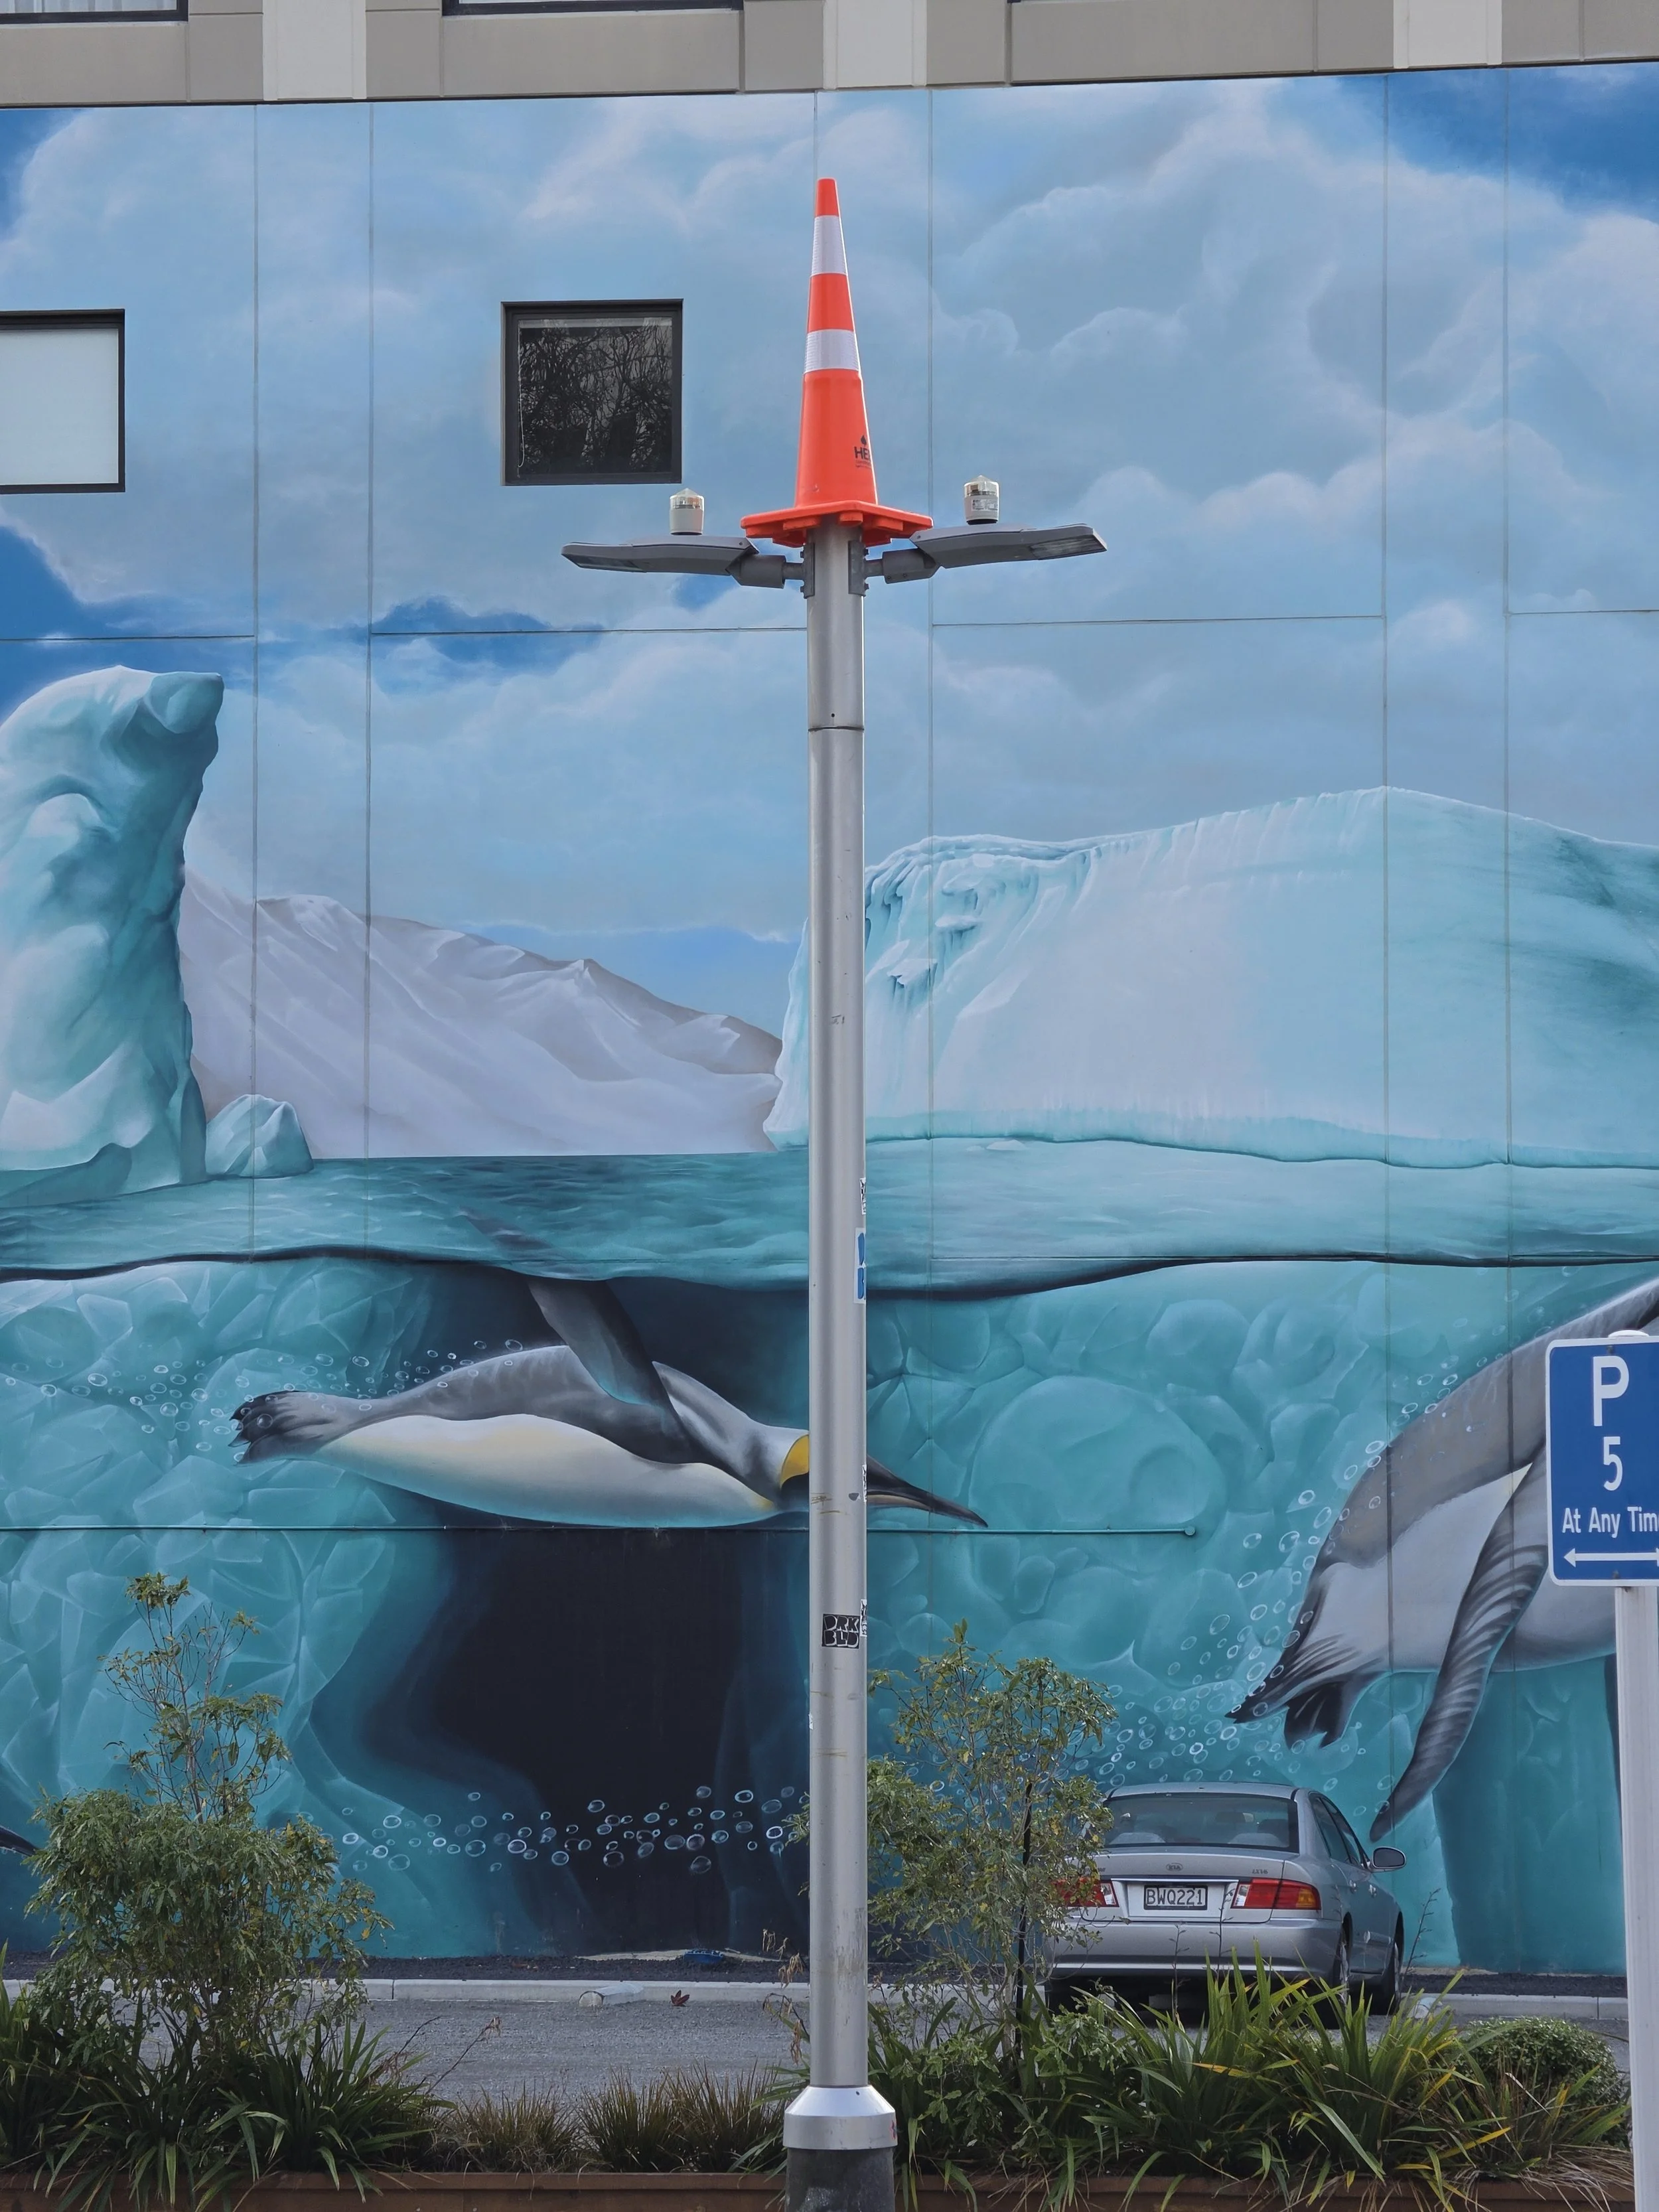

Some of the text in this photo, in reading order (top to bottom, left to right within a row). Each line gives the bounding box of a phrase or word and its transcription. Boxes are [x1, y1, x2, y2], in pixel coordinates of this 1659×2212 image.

[1592, 1355, 1630, 1427] P
[1603, 1436, 1623, 1491] 5
[1561, 1506, 1659, 1538] At Any Tim
[1146, 1888, 1203, 1905] BWQ221
